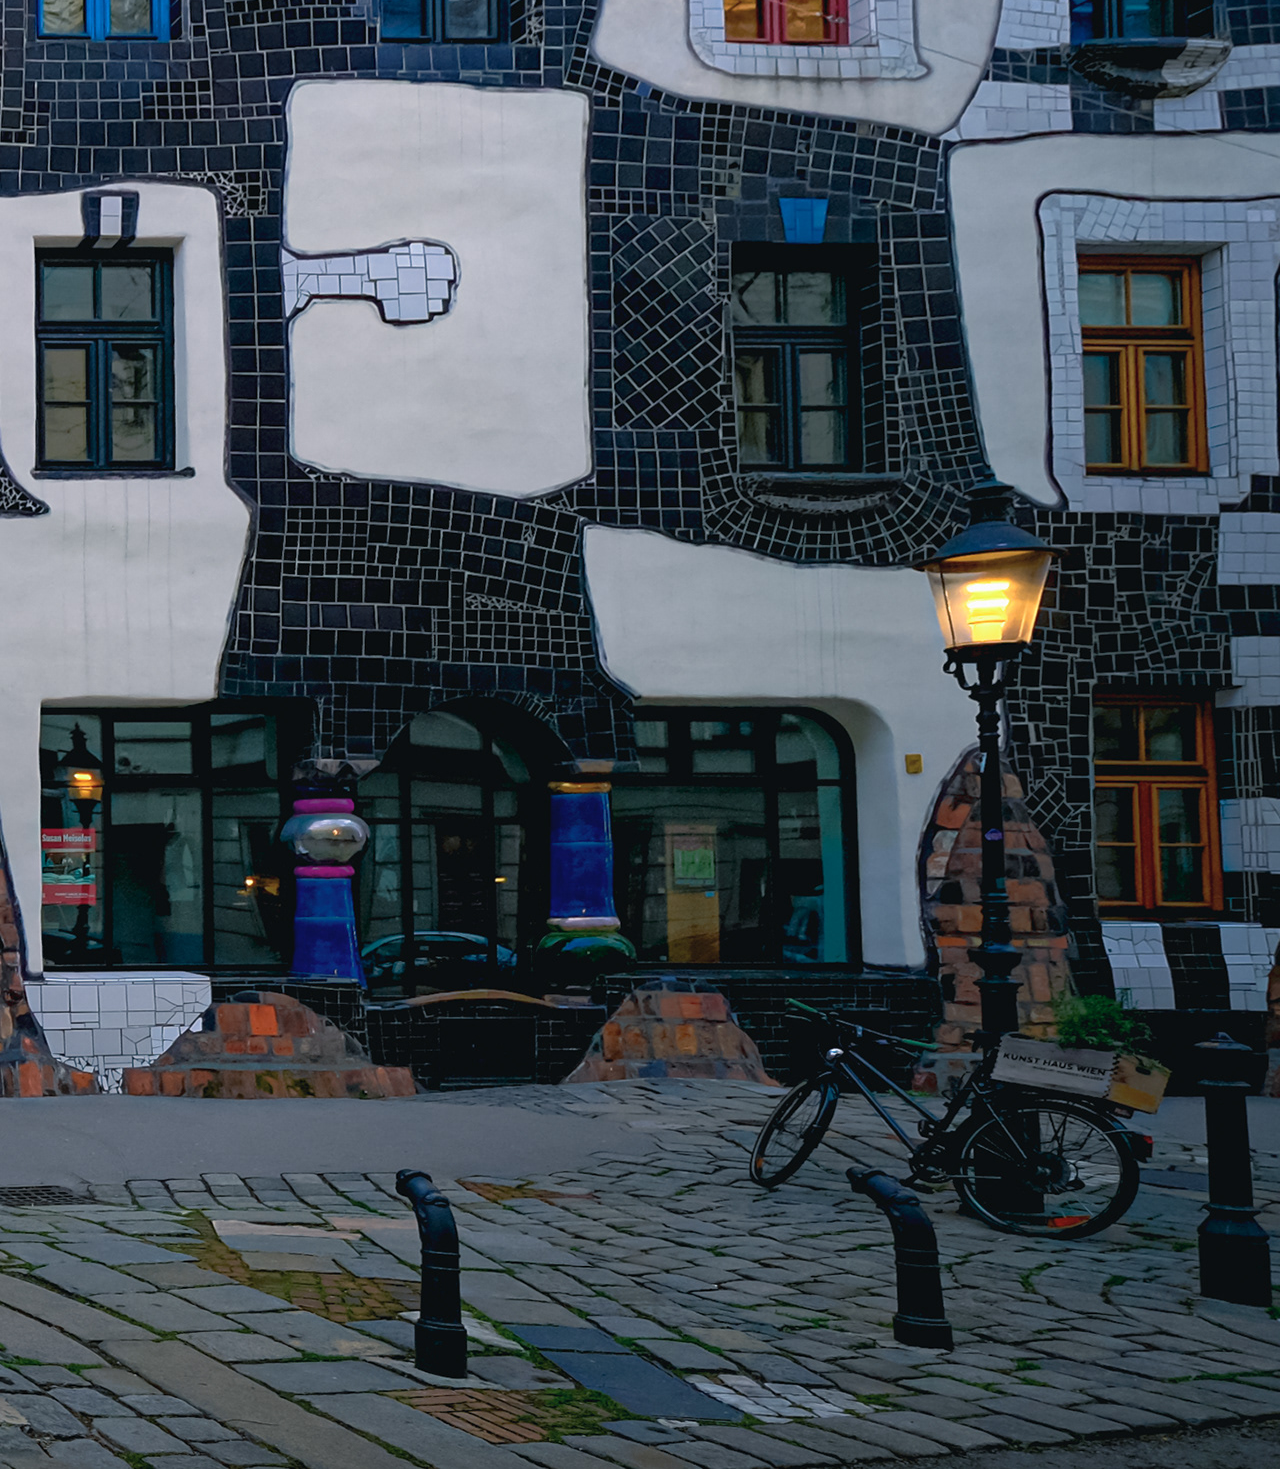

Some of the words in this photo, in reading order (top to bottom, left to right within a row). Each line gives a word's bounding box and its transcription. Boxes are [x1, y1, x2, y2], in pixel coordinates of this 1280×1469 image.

[1003, 1052, 1040, 1064] KUNST
[1043, 1059, 1073, 1070] HAUS
[1077, 1065, 1106, 1075] WIEN
